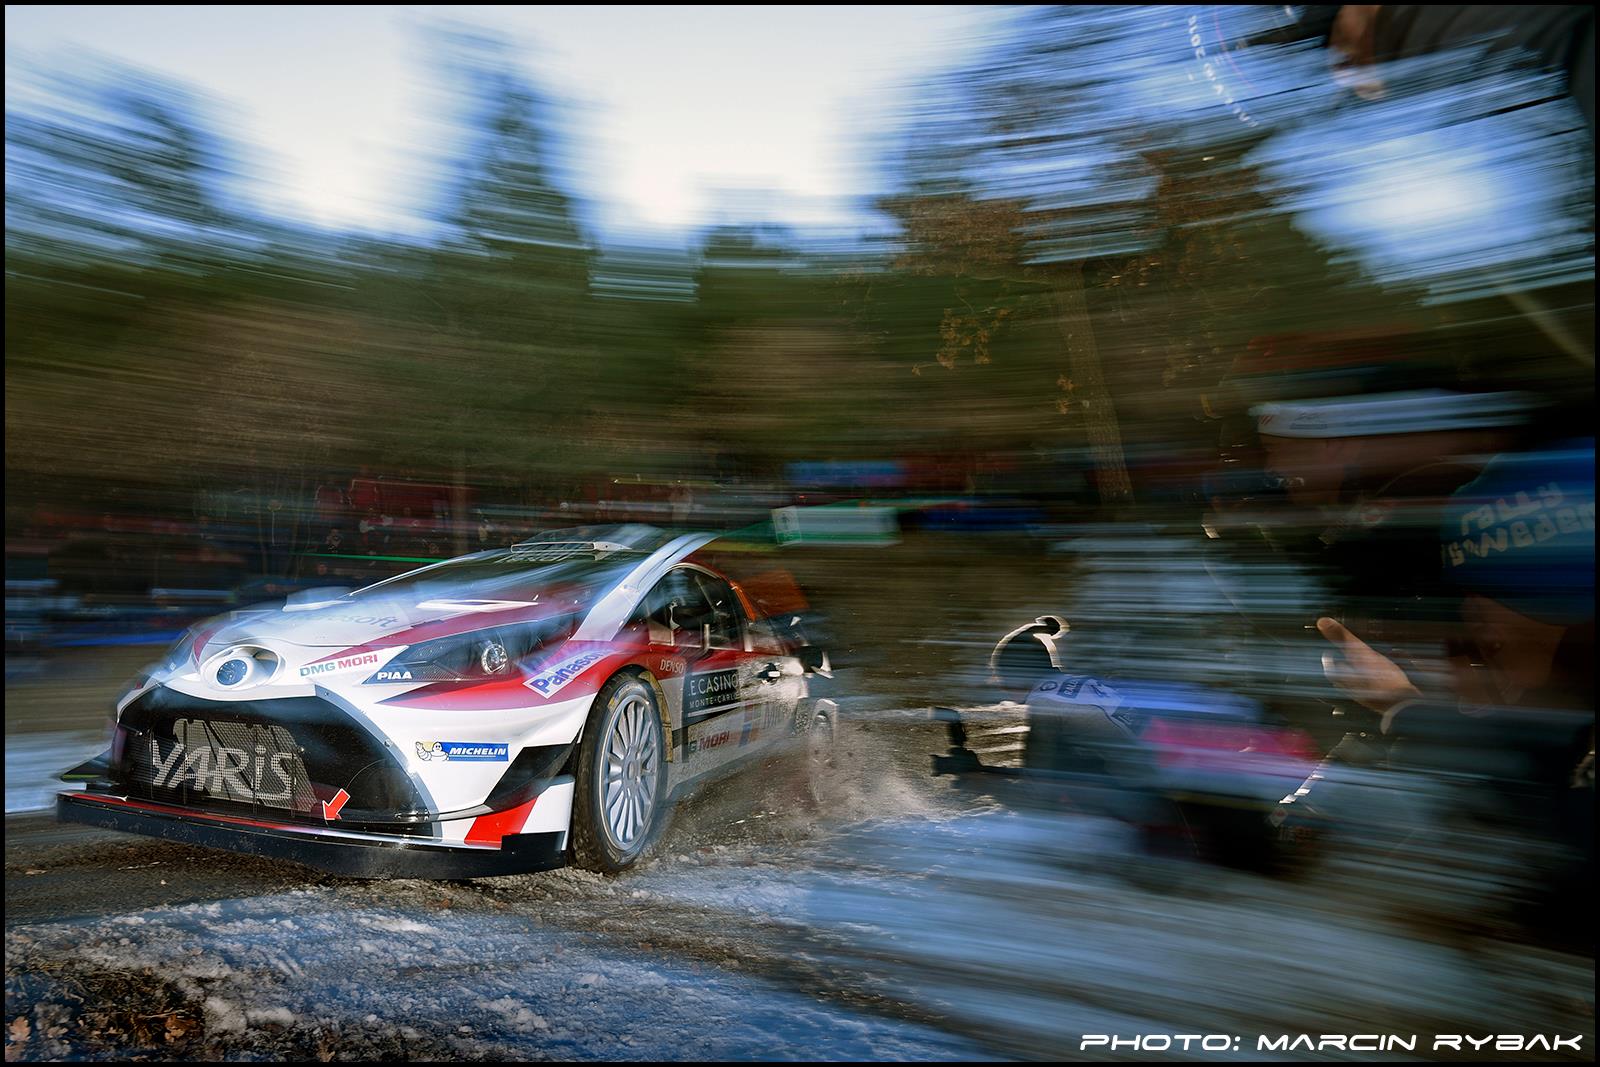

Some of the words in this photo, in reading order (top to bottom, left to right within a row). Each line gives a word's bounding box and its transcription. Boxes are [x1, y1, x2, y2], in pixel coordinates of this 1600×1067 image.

[300, 662, 336, 678] DMG
[337, 653, 379, 669] MORI
[659, 658, 685, 674] DENSO
[376, 670, 413, 681] PIAA
[697, 671, 740, 695] CASINO
[449, 746, 507, 757] MICHELIN
